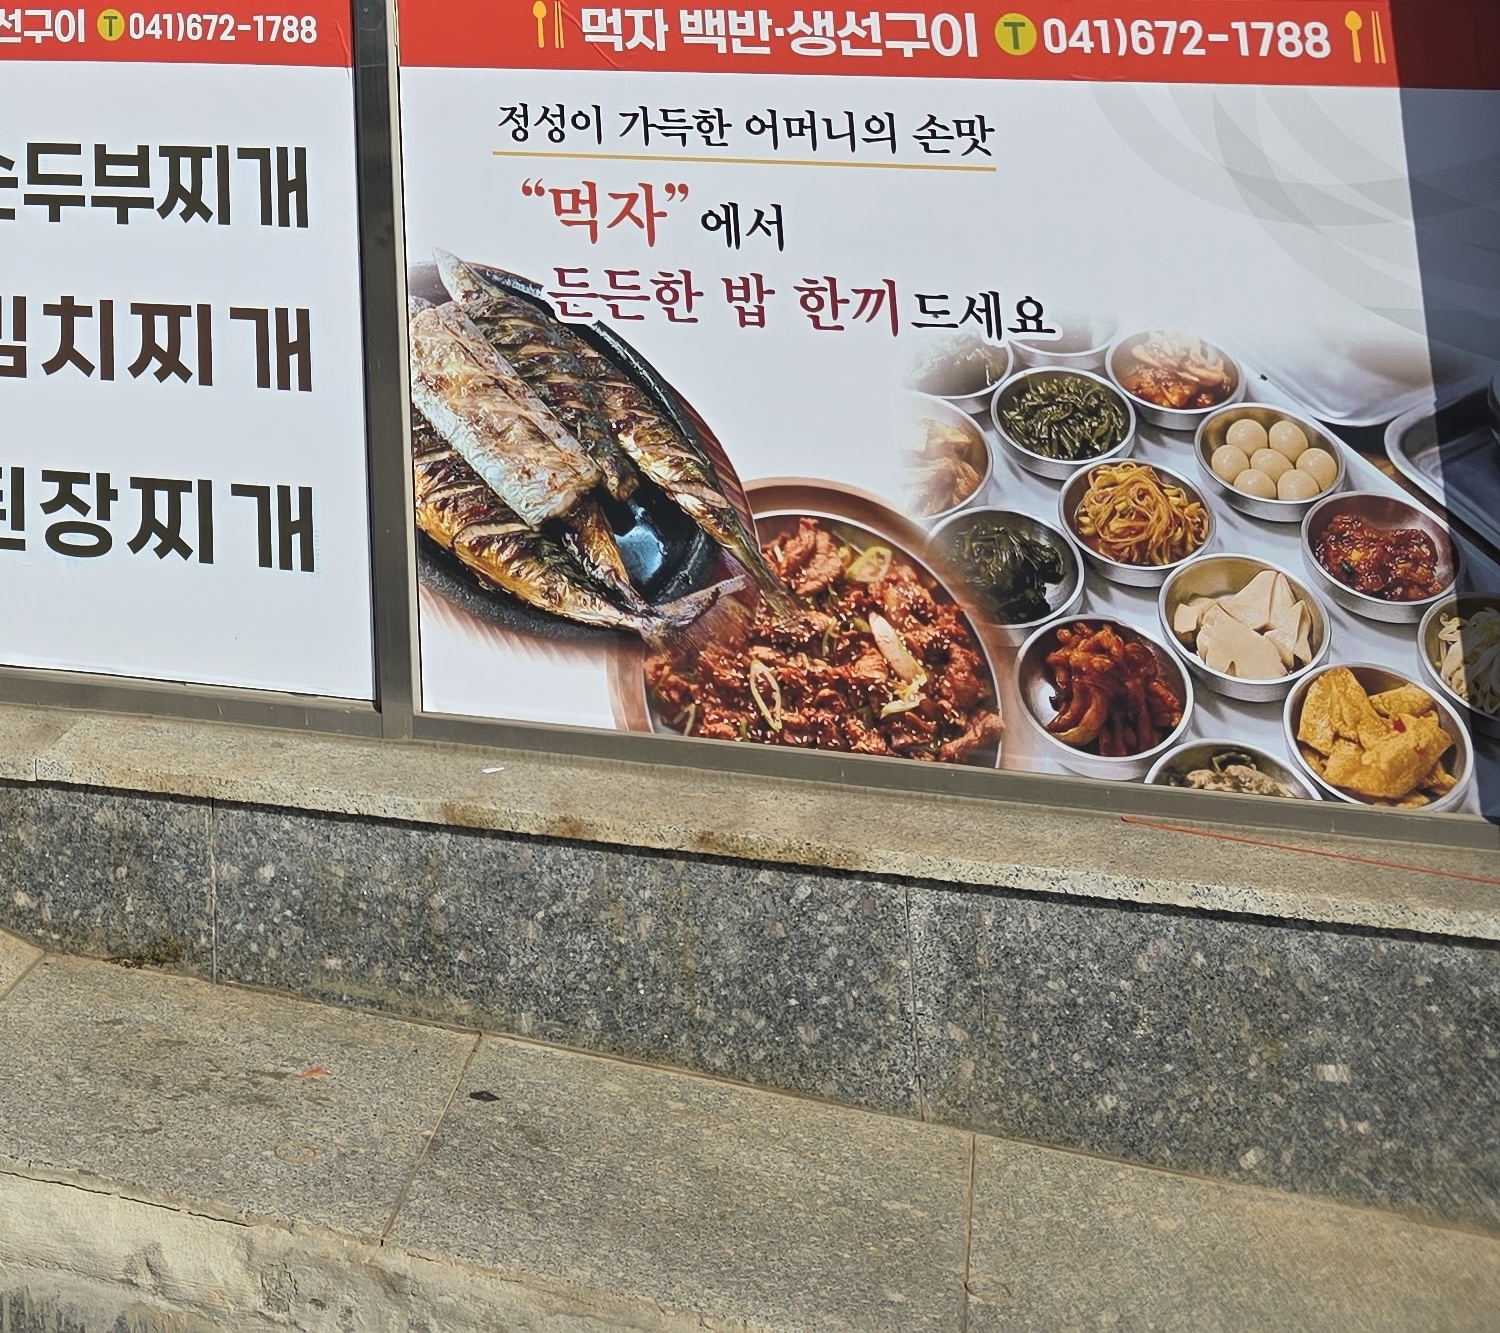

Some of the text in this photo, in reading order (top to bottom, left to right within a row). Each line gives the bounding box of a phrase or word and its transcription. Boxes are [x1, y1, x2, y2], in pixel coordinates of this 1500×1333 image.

[129, 12, 318, 44] 041)672-1788
[581, 7, 669, 52] 먹자
[1043, 17, 1331, 59] 041)672-1788
[497, 102, 996, 158] 정성이 가득한 어머니의 손맛
[700, 201, 785, 252] 에서
[547, 267, 1057, 341] 든든한 밥 한끼 드세요
